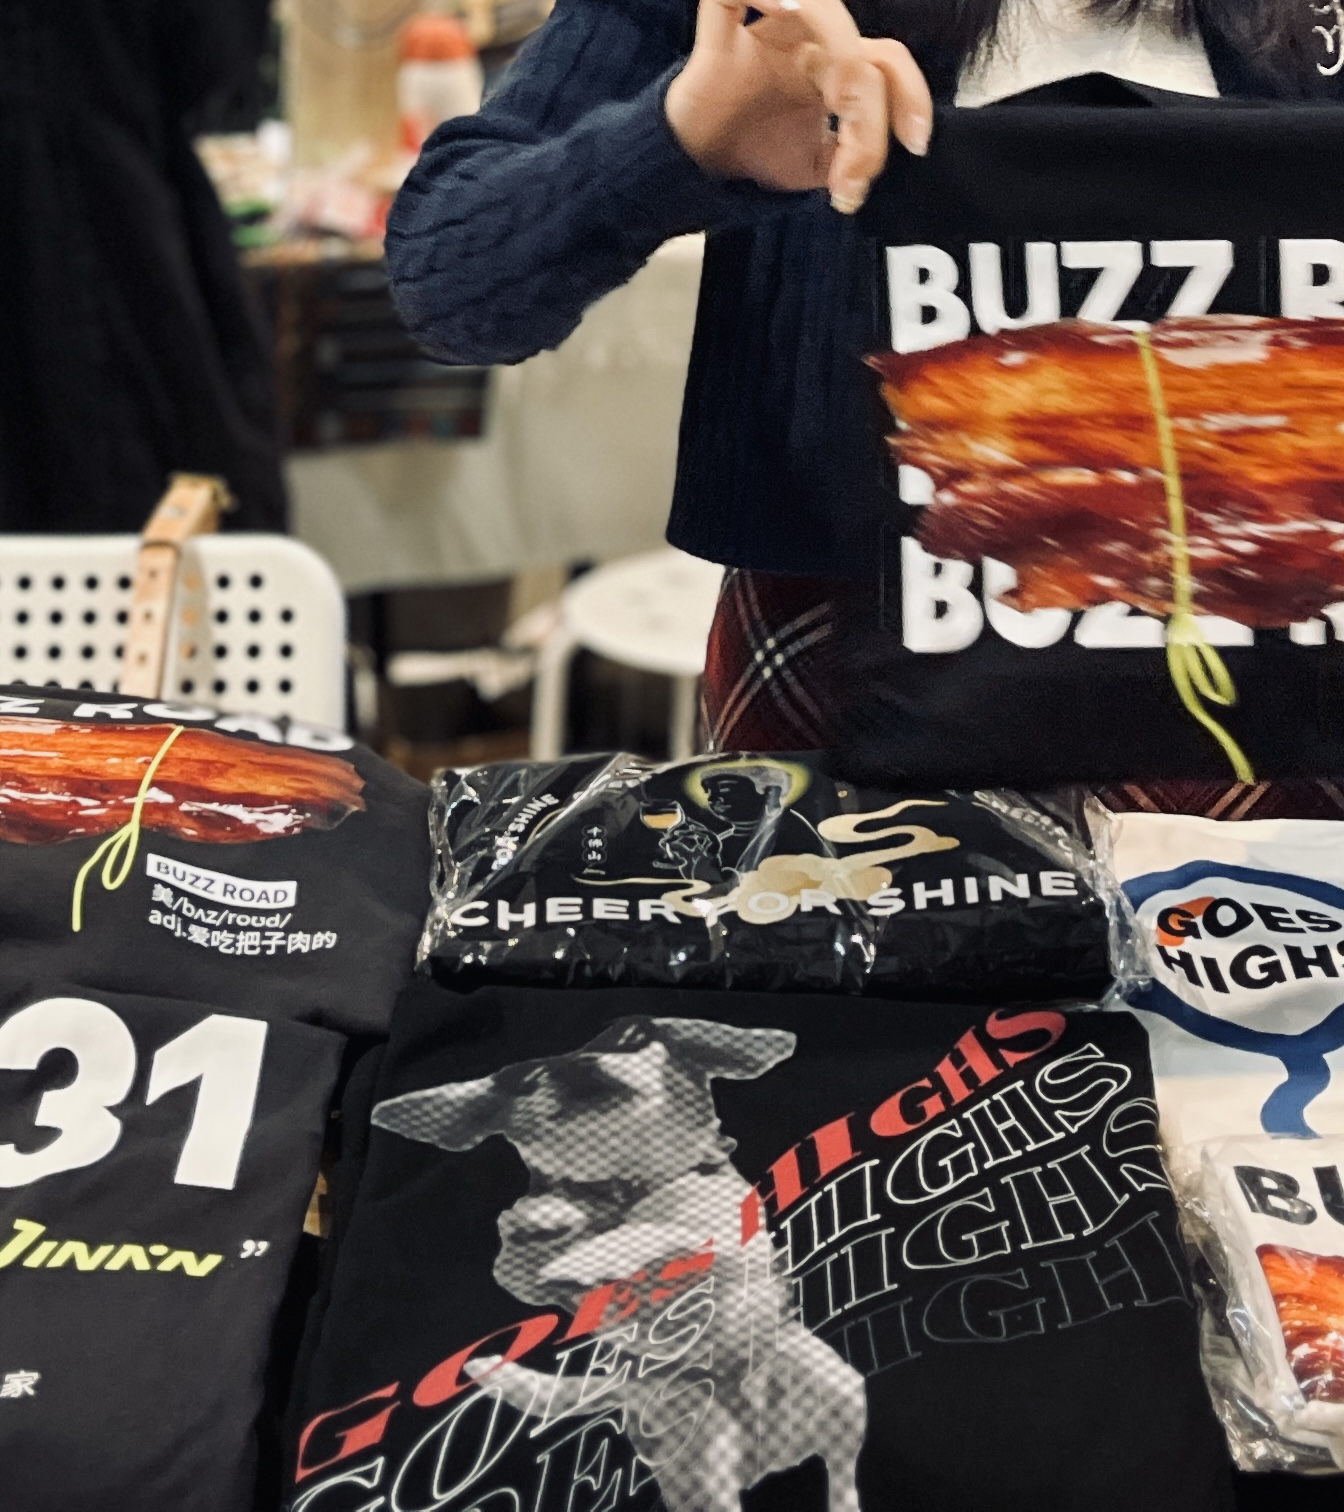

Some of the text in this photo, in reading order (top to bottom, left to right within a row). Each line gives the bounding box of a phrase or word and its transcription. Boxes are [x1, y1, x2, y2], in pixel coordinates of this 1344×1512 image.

[886, 239, 1234, 353] BUZZ
[508, 793, 559, 833] SHINE
[156, 860, 289, 905] BUZZ ROAD
[450, 895, 682, 931] CHEER
[867, 870, 1080, 919] SHINE
[1156, 896, 1343, 939] GOES
[739, 1007, 1067, 1249] HIGHS
